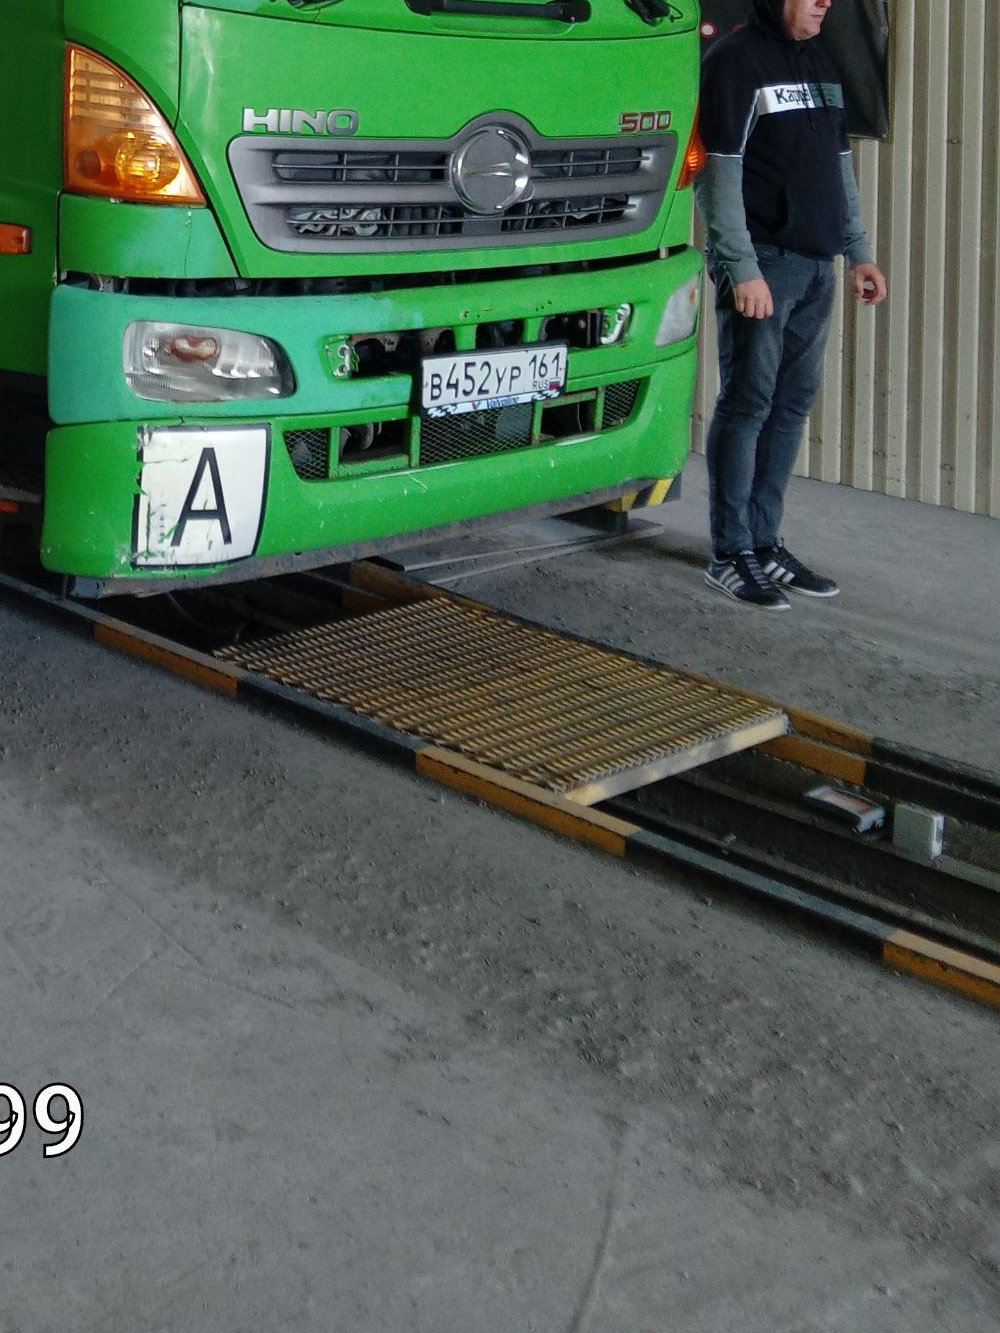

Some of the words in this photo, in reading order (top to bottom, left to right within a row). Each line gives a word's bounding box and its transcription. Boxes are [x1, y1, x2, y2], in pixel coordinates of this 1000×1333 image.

[243, 107, 359, 135] HINO
[619, 110, 672, 133] 500
[529, 351, 560, 380] 161
[532, 379, 549, 390] RUS
[170, 447, 232, 547] A
